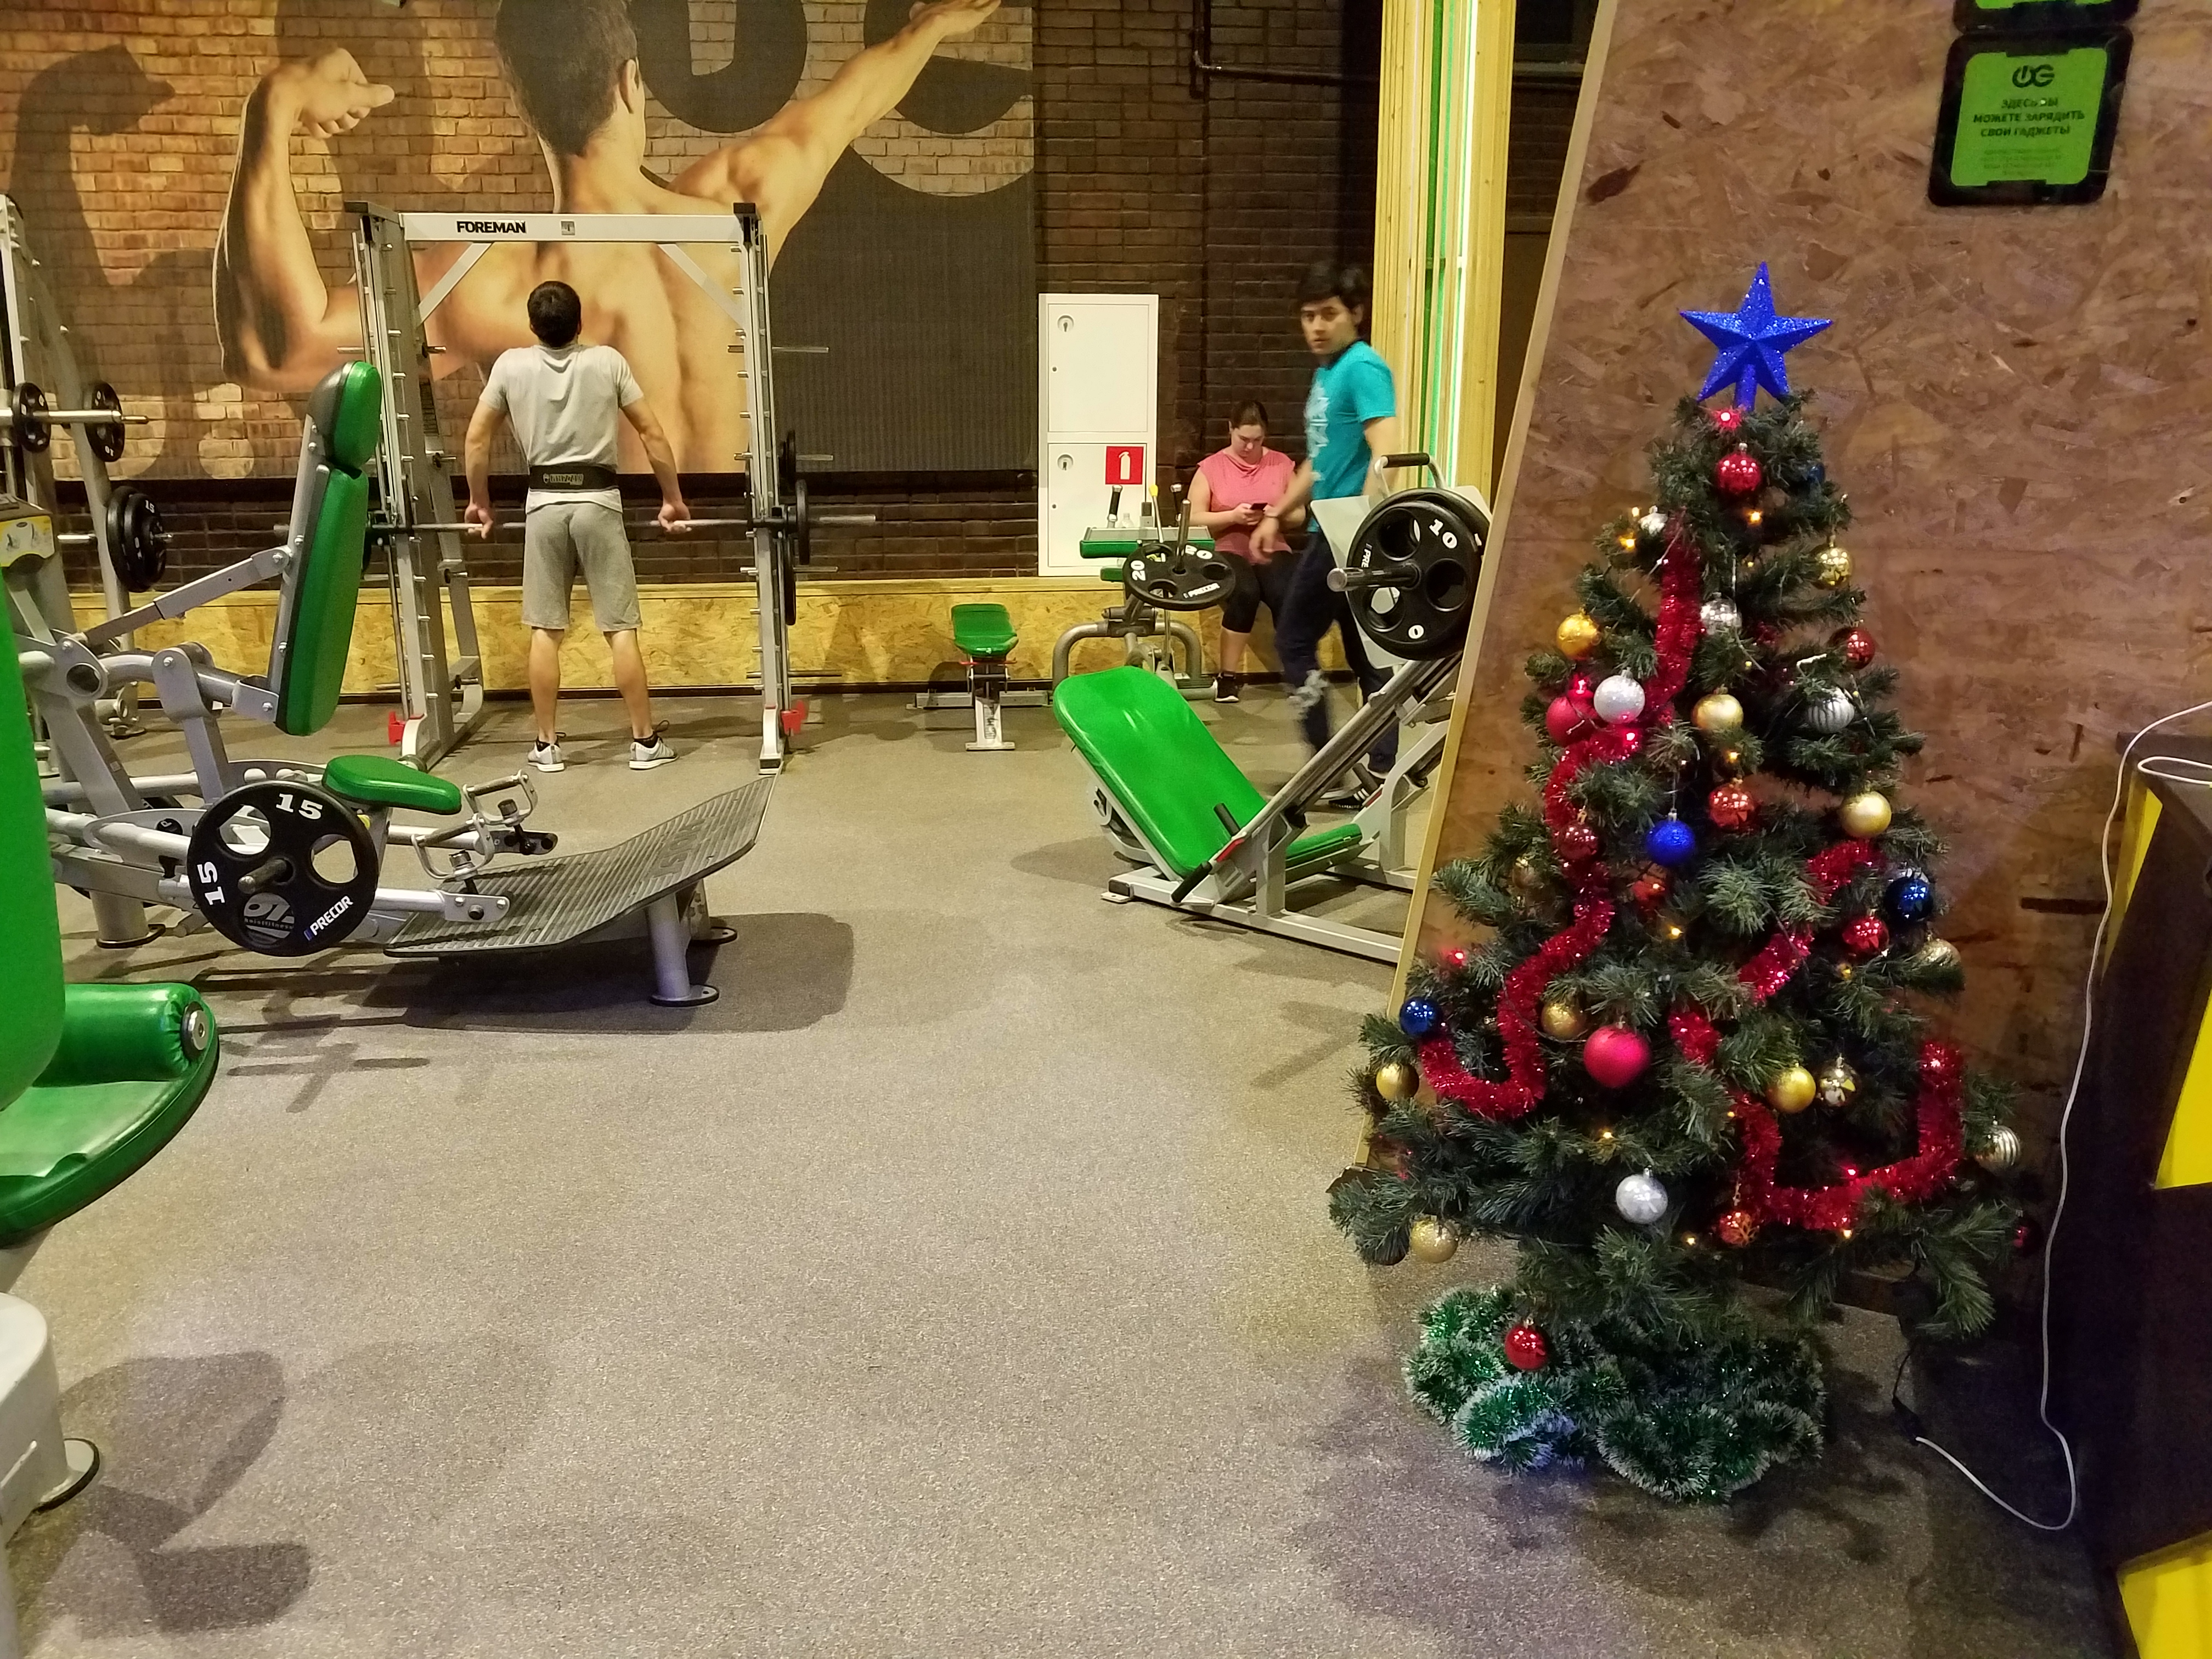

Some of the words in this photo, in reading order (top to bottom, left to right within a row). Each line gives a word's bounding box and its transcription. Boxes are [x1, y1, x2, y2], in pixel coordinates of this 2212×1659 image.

[1974, 113, 2021, 123] МОЖЕТЕ
[2025, 110, 2085, 122] ЗАРЯДИТЬ
[1981, 128, 2011, 137] СВОИ
[2015, 126, 2070, 137] ГАДЖЕТЫ
[456, 221, 526, 233] FOREMAN
[145, 500, 155, 514] 15
[1429, 519, 1458, 549] 10
[1131, 560, 1146, 581] 20
[276, 793, 323, 820] 15
[197, 861, 225, 905] 15
[309, 895, 353, 935] PRECOR
